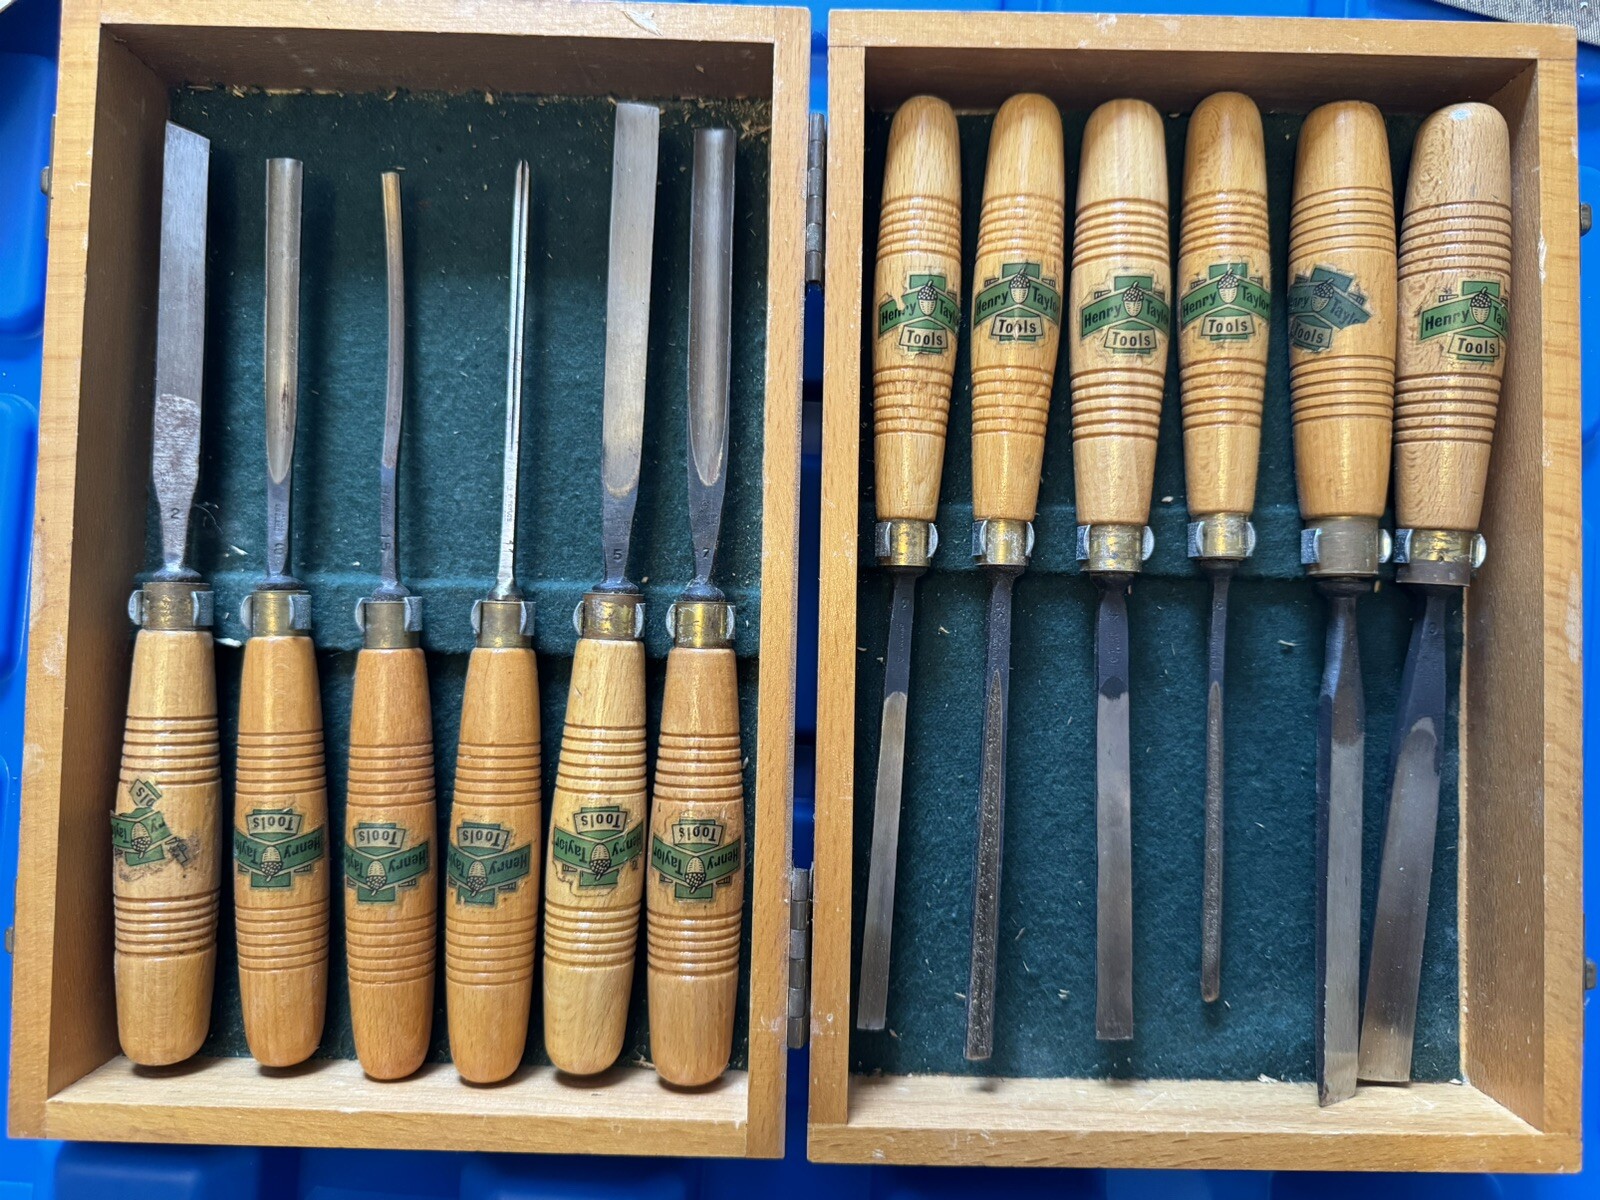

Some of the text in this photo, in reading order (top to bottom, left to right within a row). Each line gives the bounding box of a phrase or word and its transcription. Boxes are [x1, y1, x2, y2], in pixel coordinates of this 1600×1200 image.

[976, 286, 1059, 316] Henry Taylo
[1183, 292, 1217, 316] Henry
[881, 301, 917, 326] Heny
[1084, 304, 1122, 328] Henry
[1425, 309, 1469, 331] Henry
[1208, 319, 1248, 333] Tools
[907, 330, 943, 346] Tools
[1112, 332, 1151, 347] Tools
[1457, 338, 1496, 354] Tools
[170, 507, 181, 520] 2
[613, 548, 623, 561] 5
[702, 547, 711, 558] 7
[253, 815, 294, 832] Tools
[582, 813, 621, 828] Tools
[359, 829, 398, 845] Tools
[462, 829, 501, 847] Tools
[678, 826, 717, 842] Tools
[283, 835, 323, 859] Henry
[555, 831, 643, 864] Henry Taylor
[388, 850, 427, 873] Henry
[488, 851, 528, 875] Henry
[653, 845, 739, 876] Henry Taylor
